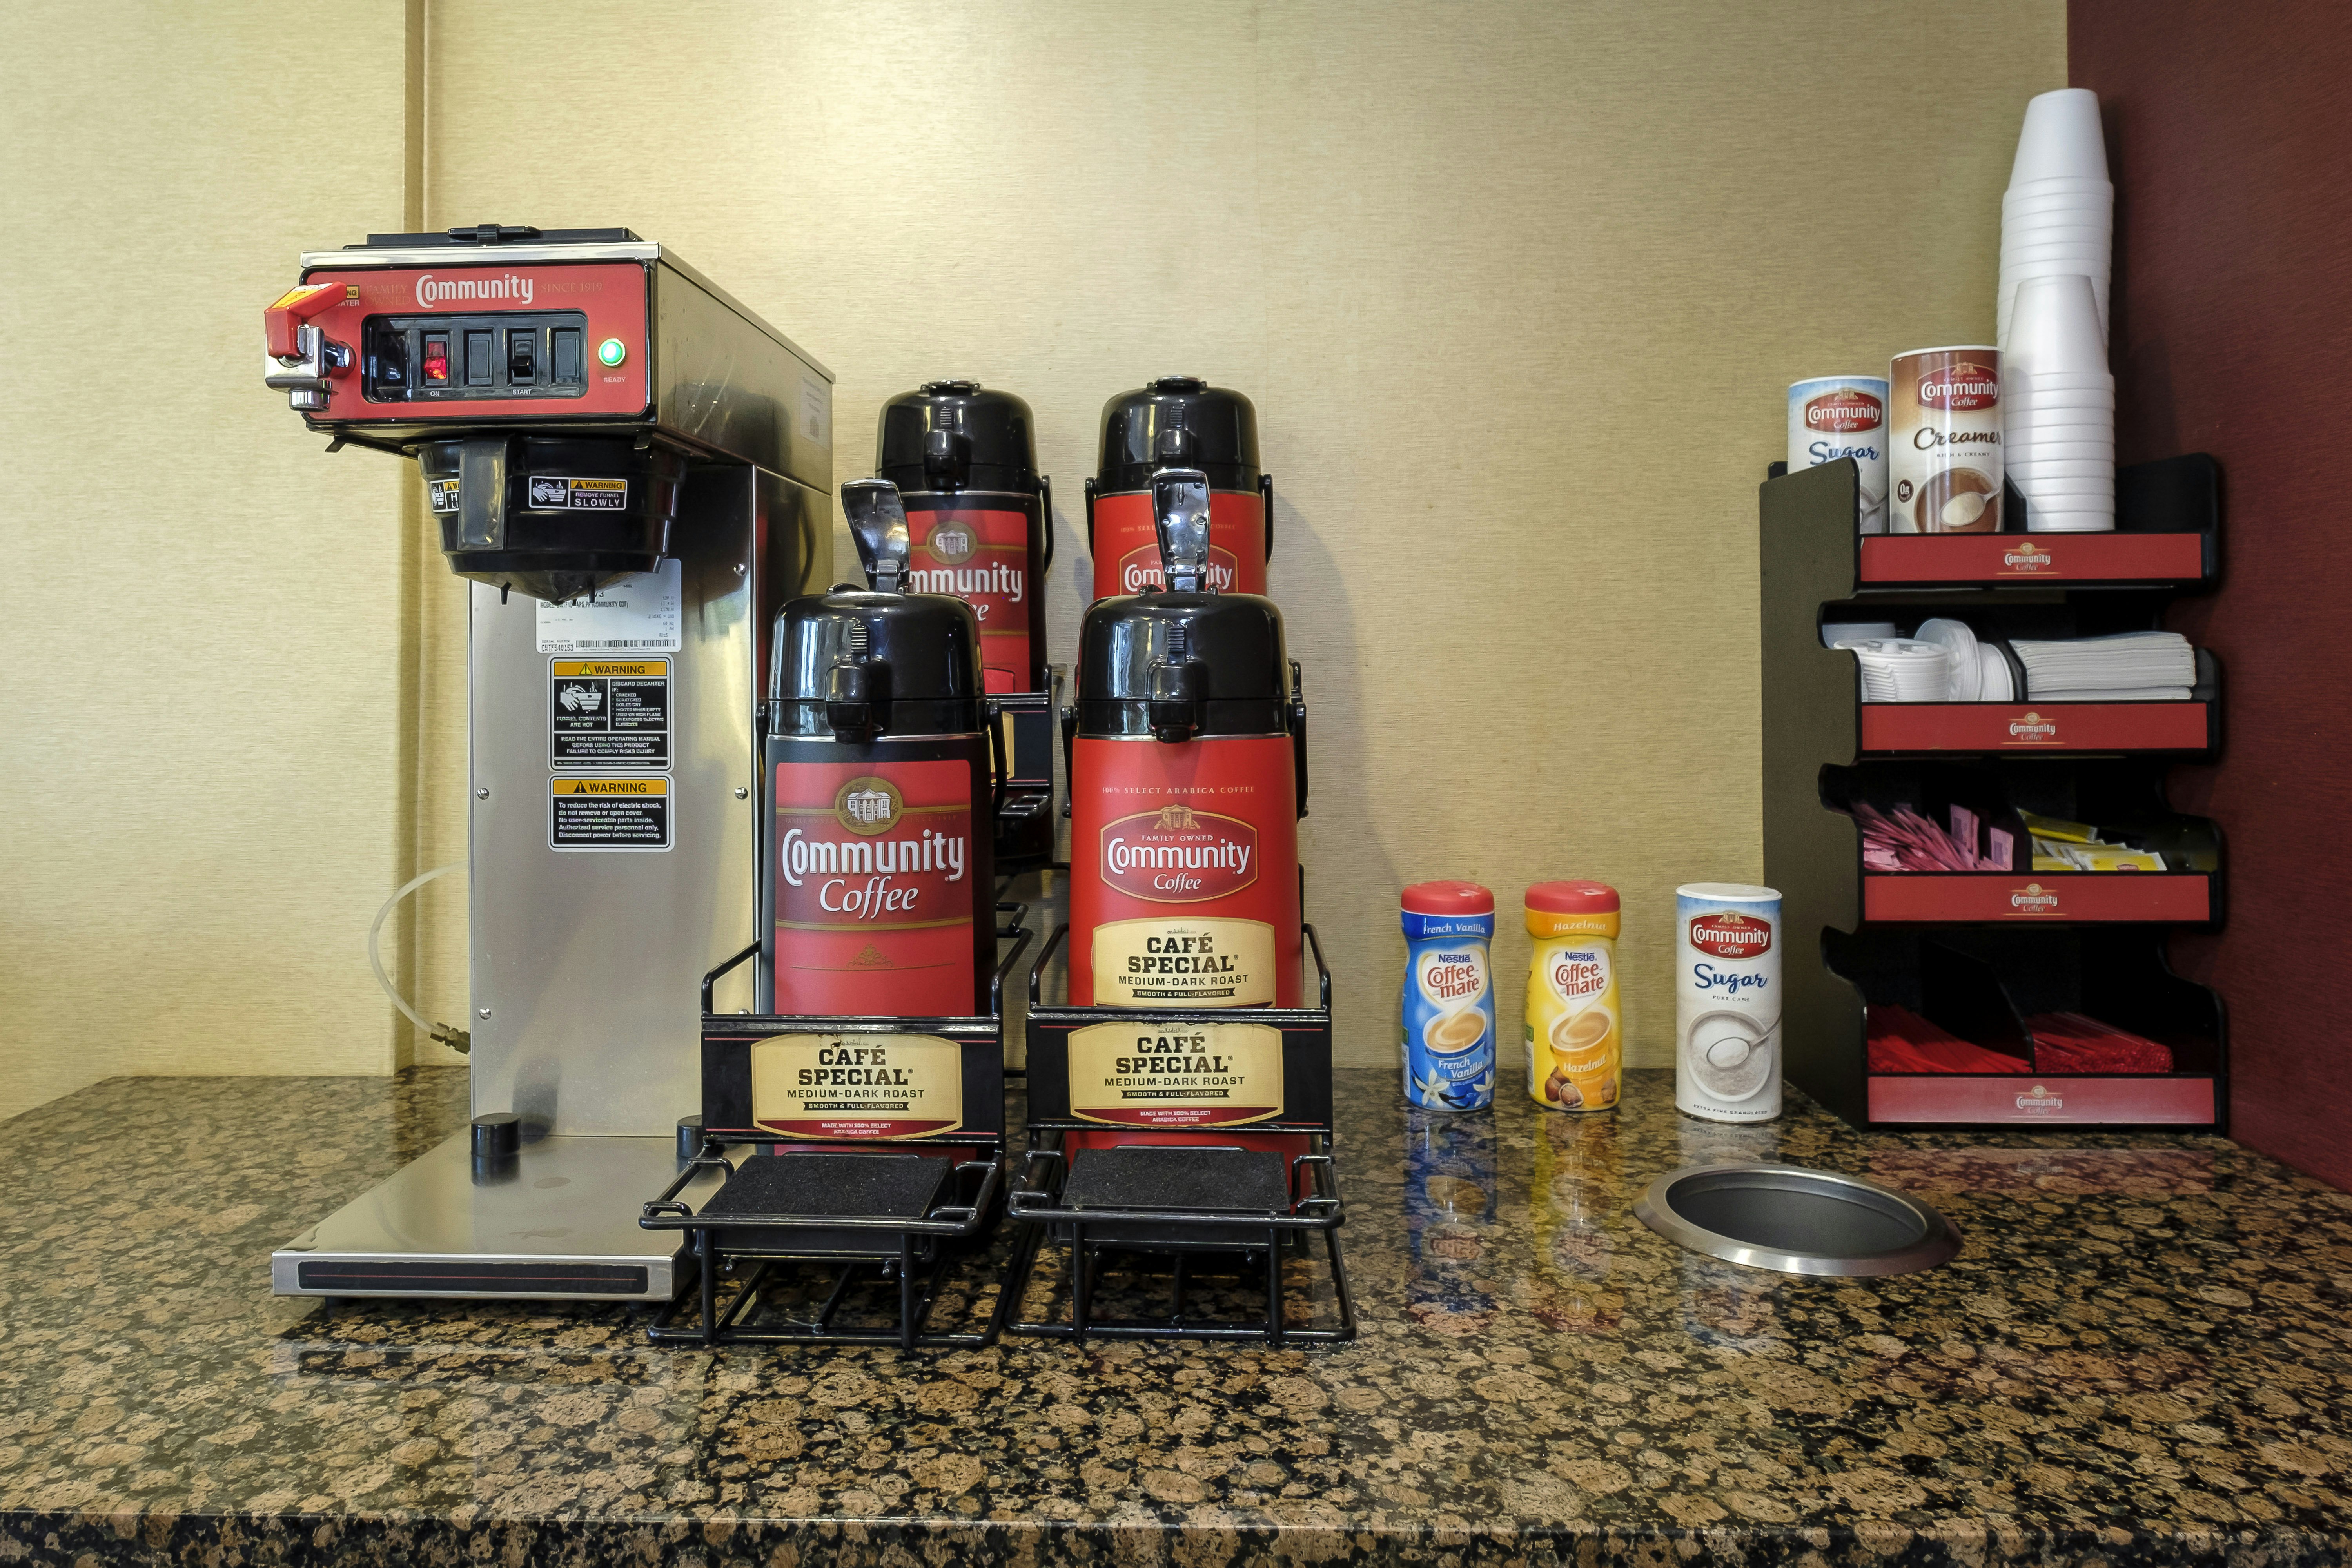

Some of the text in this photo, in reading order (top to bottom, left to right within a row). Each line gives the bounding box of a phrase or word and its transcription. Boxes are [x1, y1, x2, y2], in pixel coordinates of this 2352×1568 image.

[366, 284, 408, 294] FAMILY
[416, 274, 533, 308] Community
[541, 282, 602, 293] SINCE 1919
[365, 296, 410, 305] OWNED
[1922, 379, 1999, 401] Community
[1952, 396, 1978, 407] Coffee
[1808, 404, 1880, 424] Community
[1834, 419, 1858, 429] Coffee
[2005, 554, 2051, 566] Community
[910, 561, 1022, 602] mmunity
[1125, 563, 1232, 592] Comity
[595, 666, 645, 674] WARNING
[2009, 723, 2055, 735] Community
[589, 783, 646, 793] WARNING
[783, 828, 964, 886] Community
[1108, 838, 1250, 875] Community
[1154, 873, 1201, 893] Coffee
[820, 876, 918, 919] Coffee
[2012, 894, 2057, 907] Community
[1424, 923, 1485, 934] French Vanilla
[1554, 920, 1606, 931] Hazelnut
[1147, 932, 1212, 953] CAFÉ
[1693, 924, 1769, 947] Community
[1565, 951, 1595, 961] Nestlé
[1718, 945, 1744, 955] Coffee
[1128, 955, 1234, 973] SPECIAL
[1439, 954, 1470, 963] Nestlé
[1119, 974, 1248, 985] MEDIUM-DARK ROAST
[1566, 976, 1604, 996] mate
[1694, 964, 1768, 994] Sugar
[1440, 977, 1479, 998] mate
[1137, 1032, 1205, 1054] CAFÉ
[818, 1044, 886, 1066] CAFÉ
[1439, 1057, 1470, 1069] French
[1564, 1054, 1606, 1072] Hazelnut
[1116, 1056, 1229, 1074] SPECIAL
[1451, 1061, 1482, 1078] Vanilla
[798, 1069, 908, 1085] SPECIAL
[1105, 1076, 1245, 1086] MEDIUM-DARK ROAST
[787, 1089, 925, 1098] MEDIUM-DARK ROAST
[2016, 1096, 2063, 1109] Community
